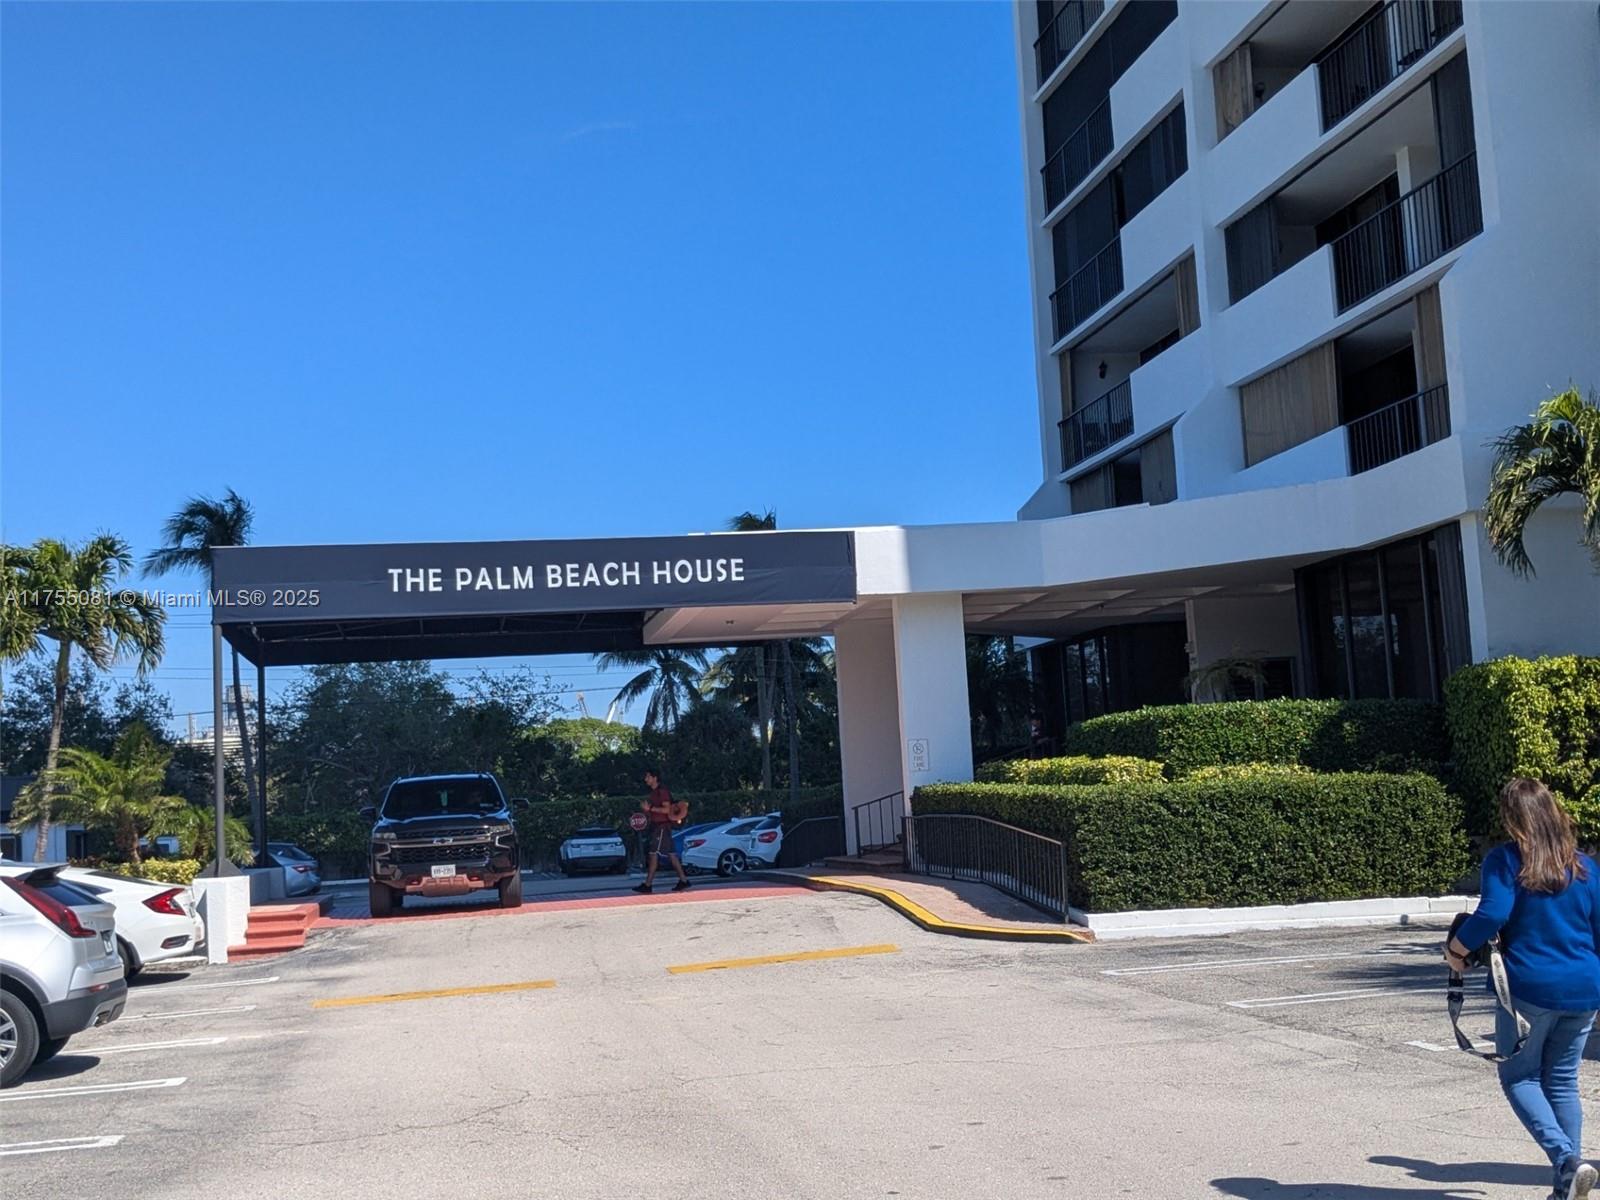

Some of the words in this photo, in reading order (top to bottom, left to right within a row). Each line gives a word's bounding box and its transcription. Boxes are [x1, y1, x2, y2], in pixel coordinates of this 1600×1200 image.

[387, 568, 443, 592] THE
[455, 565, 535, 591] PALM
[546, 561, 641, 588] BEACH
[652, 558, 745, 584] HOUSE
[631, 817, 647, 826] STOP
